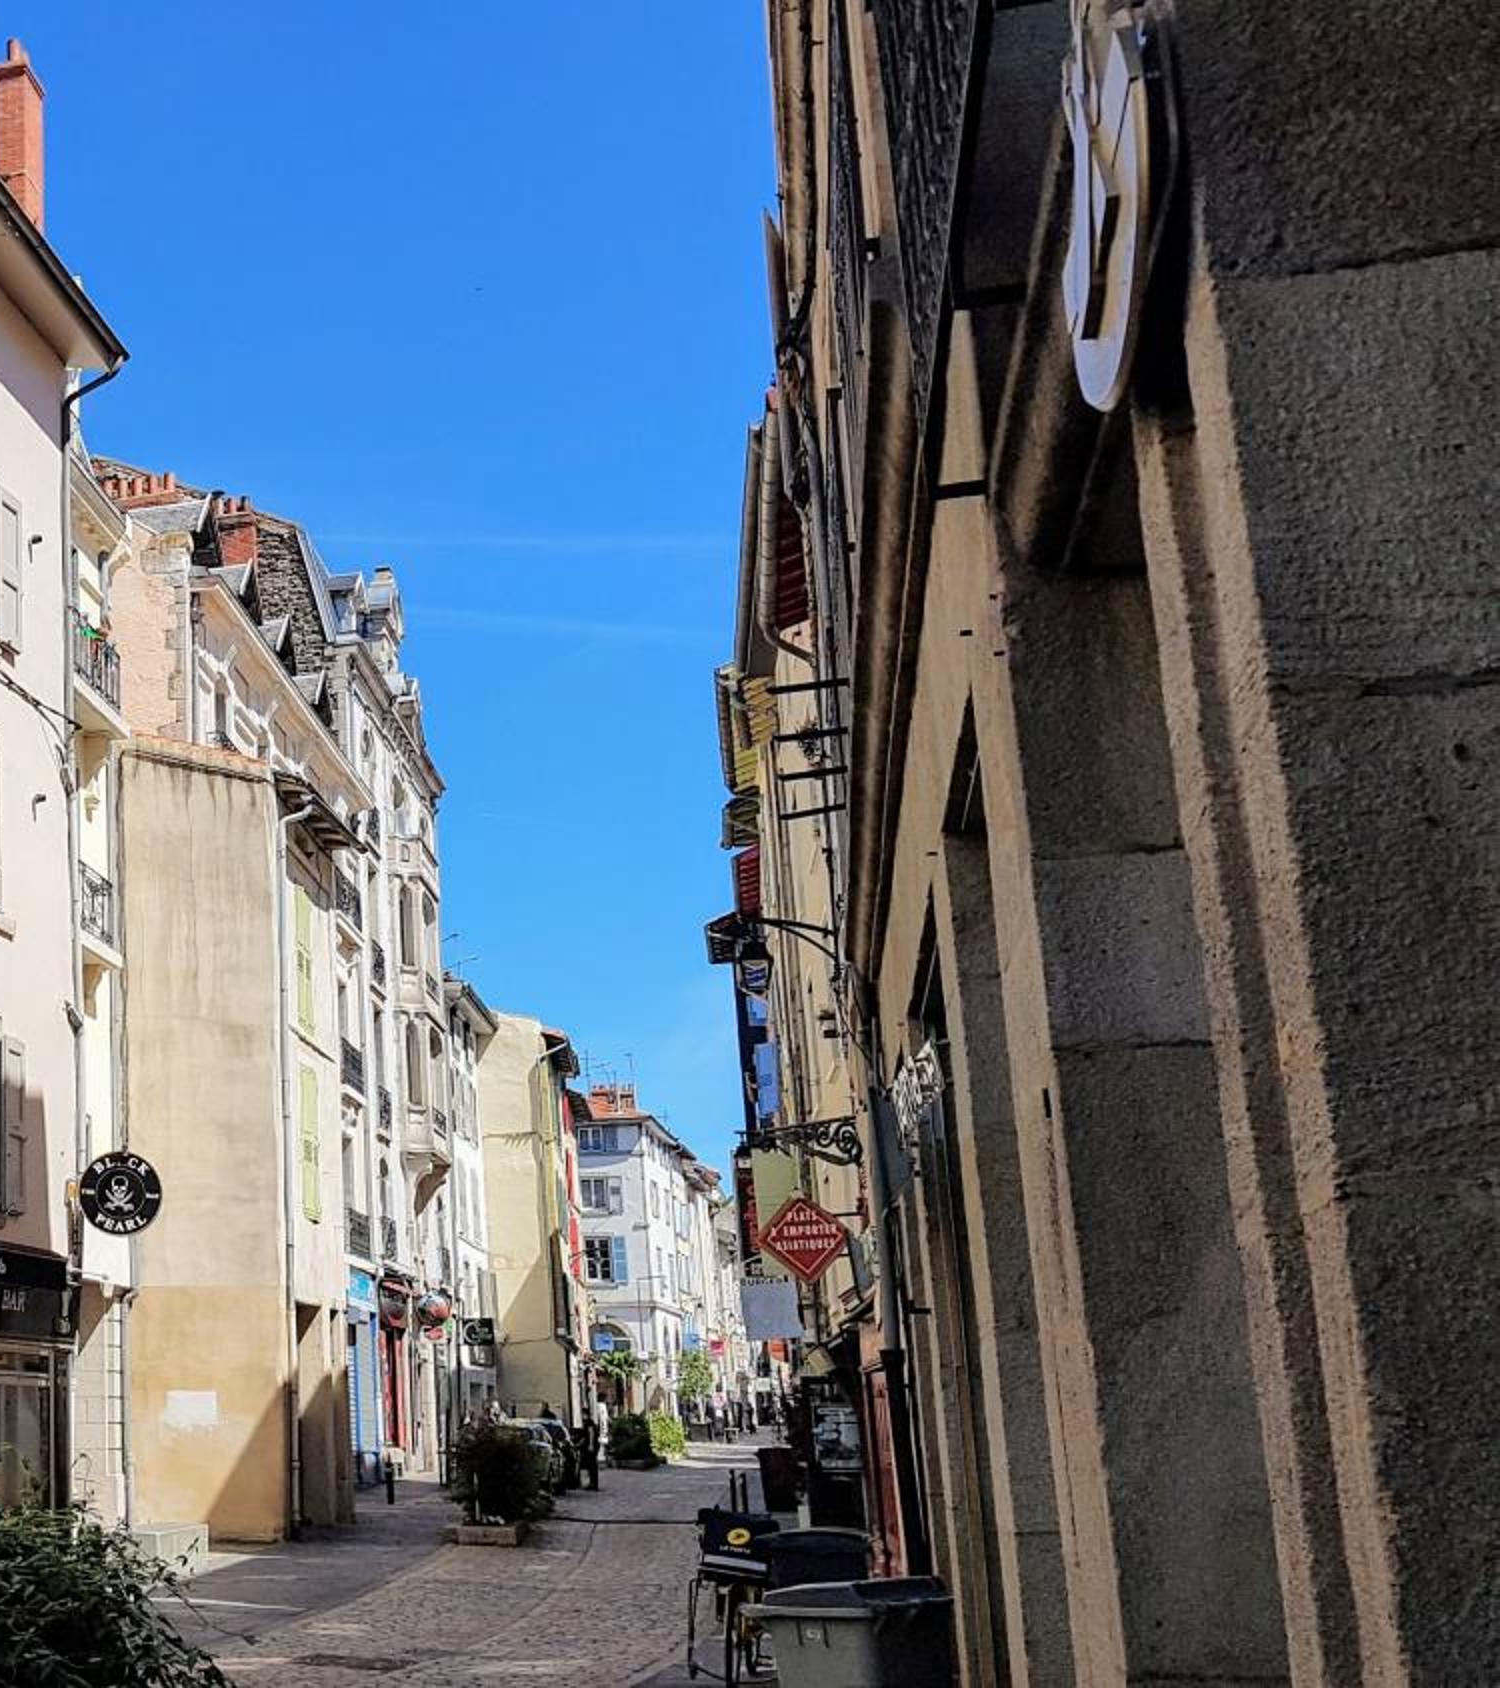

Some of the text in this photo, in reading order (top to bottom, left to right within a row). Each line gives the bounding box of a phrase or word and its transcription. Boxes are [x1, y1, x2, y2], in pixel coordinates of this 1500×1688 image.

[95, 1213, 147, 1232] PEARL
[776, 1238, 835, 1250] ASIATIQUES
[1, 1289, 27, 1312] BAR
